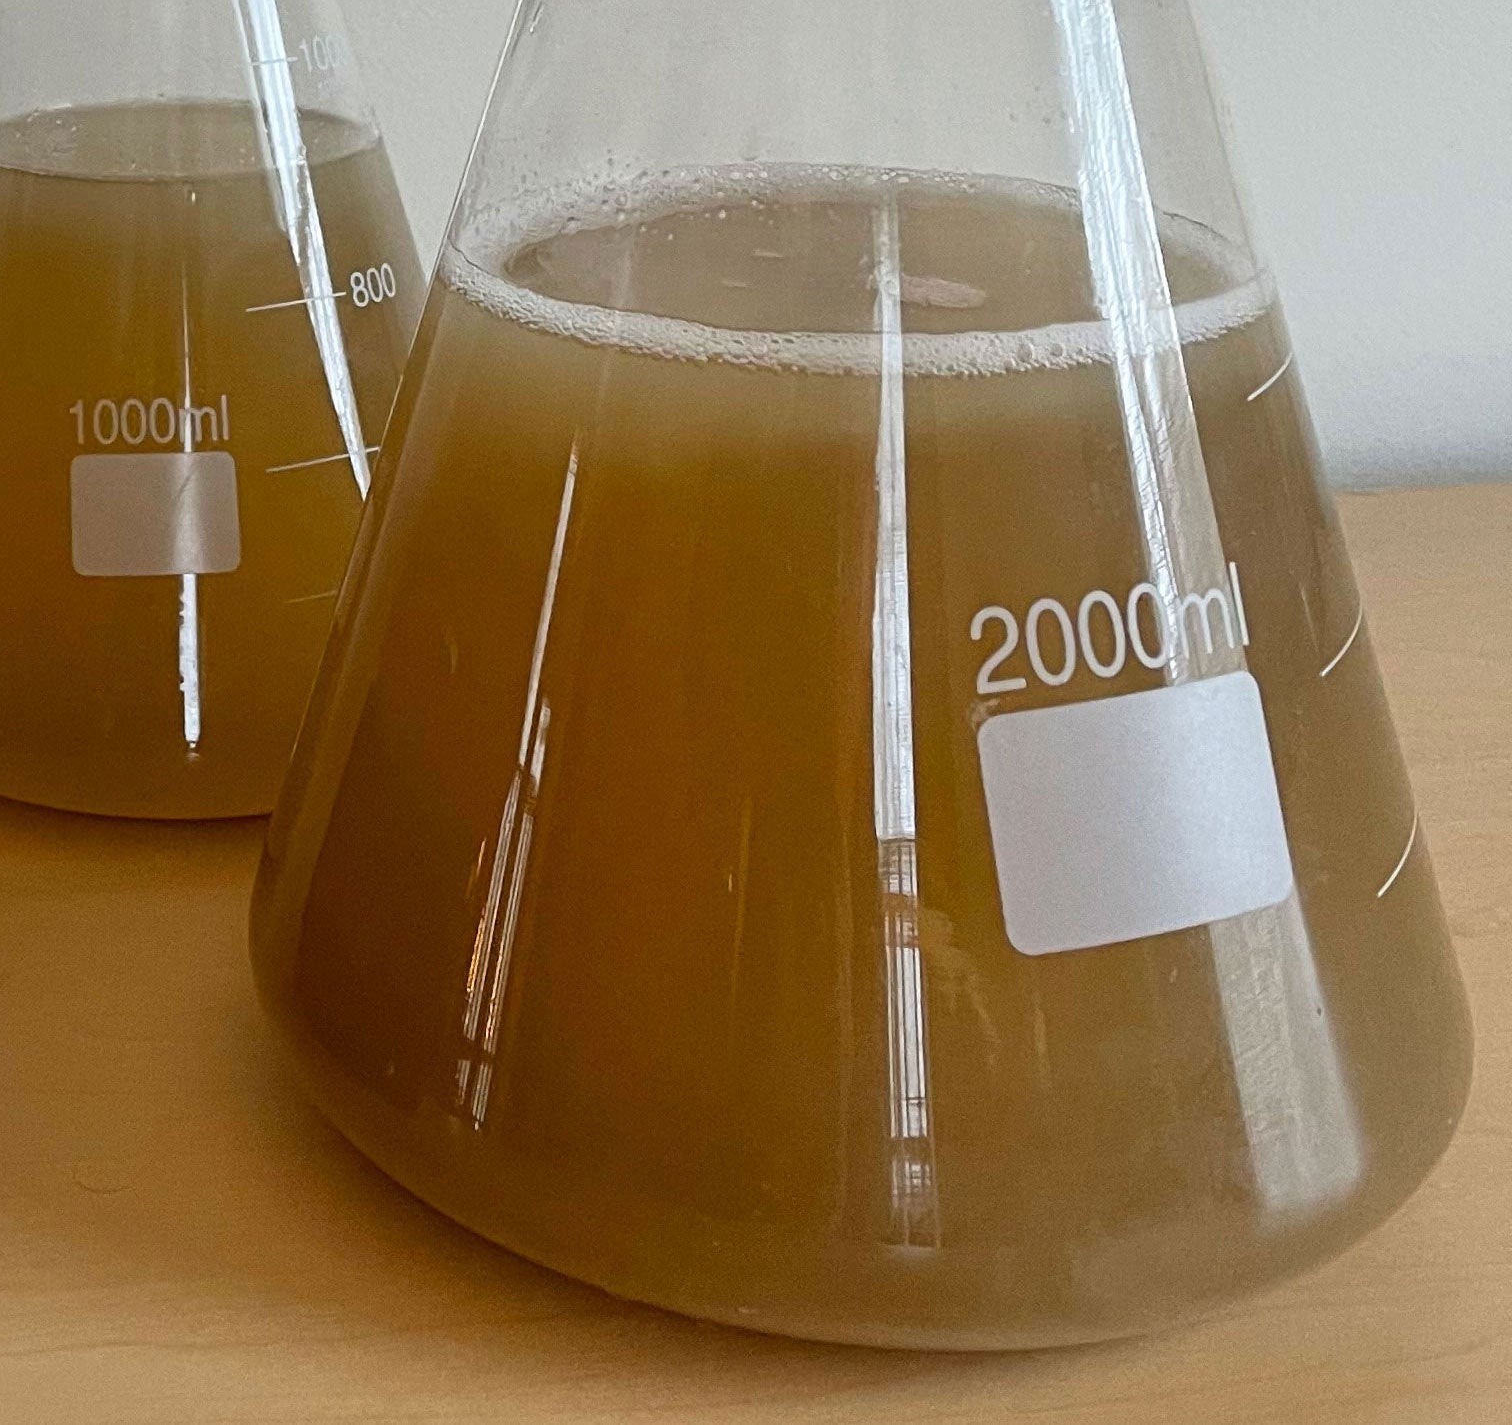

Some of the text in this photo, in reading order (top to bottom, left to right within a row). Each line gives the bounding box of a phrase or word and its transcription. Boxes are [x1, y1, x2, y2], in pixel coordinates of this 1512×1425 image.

[350, 262, 396, 308] 800
[69, 394, 230, 444] 1000ml
[970, 561, 1250, 695] 2000ml
